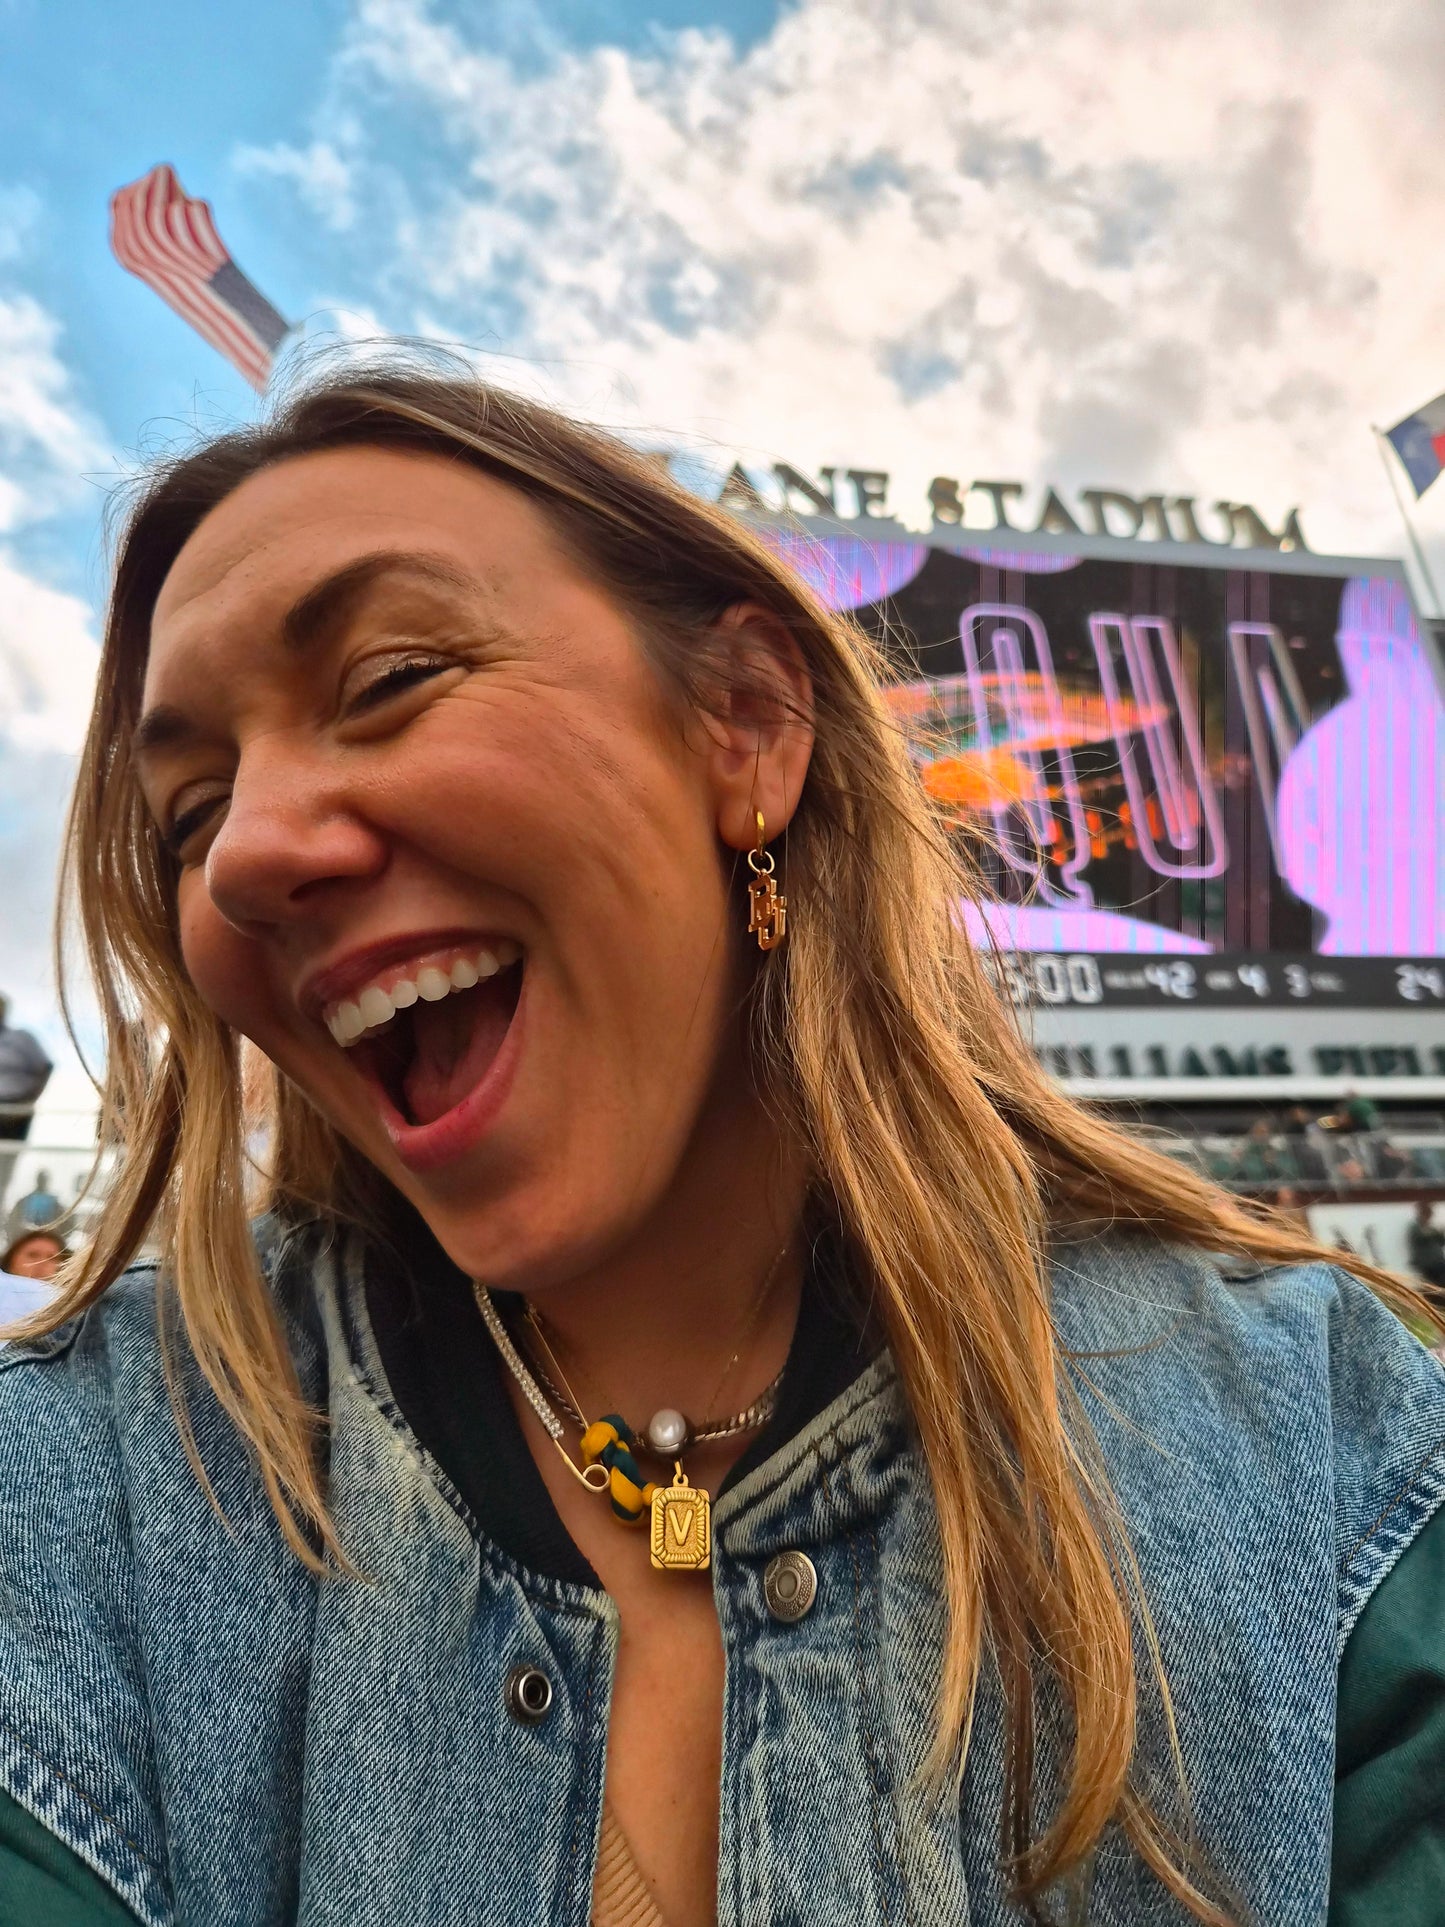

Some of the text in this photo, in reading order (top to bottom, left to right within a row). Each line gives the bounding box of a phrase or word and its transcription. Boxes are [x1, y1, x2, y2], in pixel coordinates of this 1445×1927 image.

[712, 460, 1304, 553] ANE STADIUM
[1144, 960, 1197, 999] 42
[1237, 964, 1271, 998] 4
[1283, 964, 1312, 998] 3
[668, 1508, 694, 1546] V
